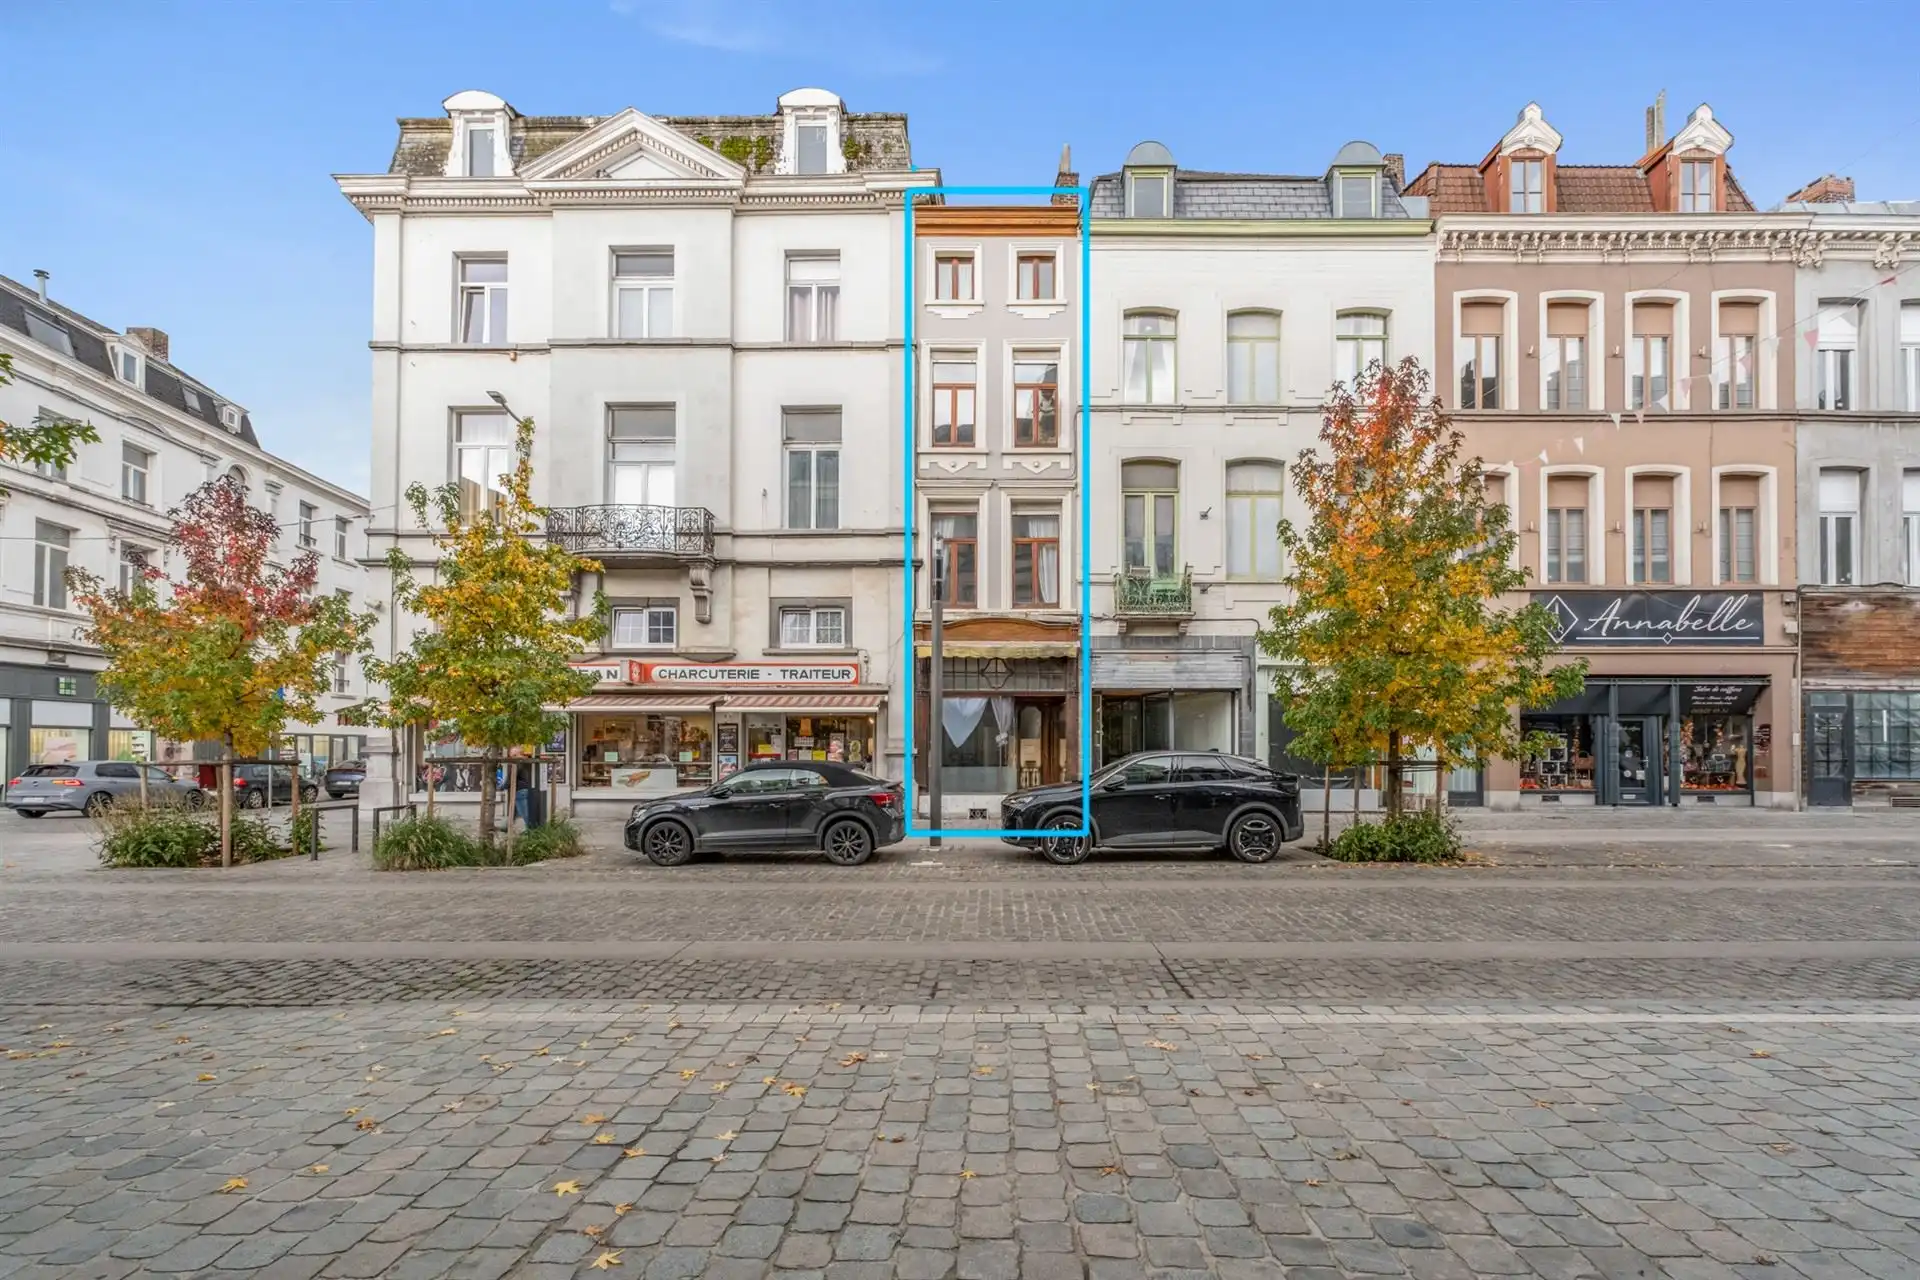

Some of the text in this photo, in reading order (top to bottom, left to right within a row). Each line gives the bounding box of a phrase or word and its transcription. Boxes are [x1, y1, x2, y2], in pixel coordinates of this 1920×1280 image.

[1584, 594, 1753, 636] Annabelle
[658, 669, 760, 680] CHARCUTERIE
[780, 669, 850, 680] TRAITEUR
